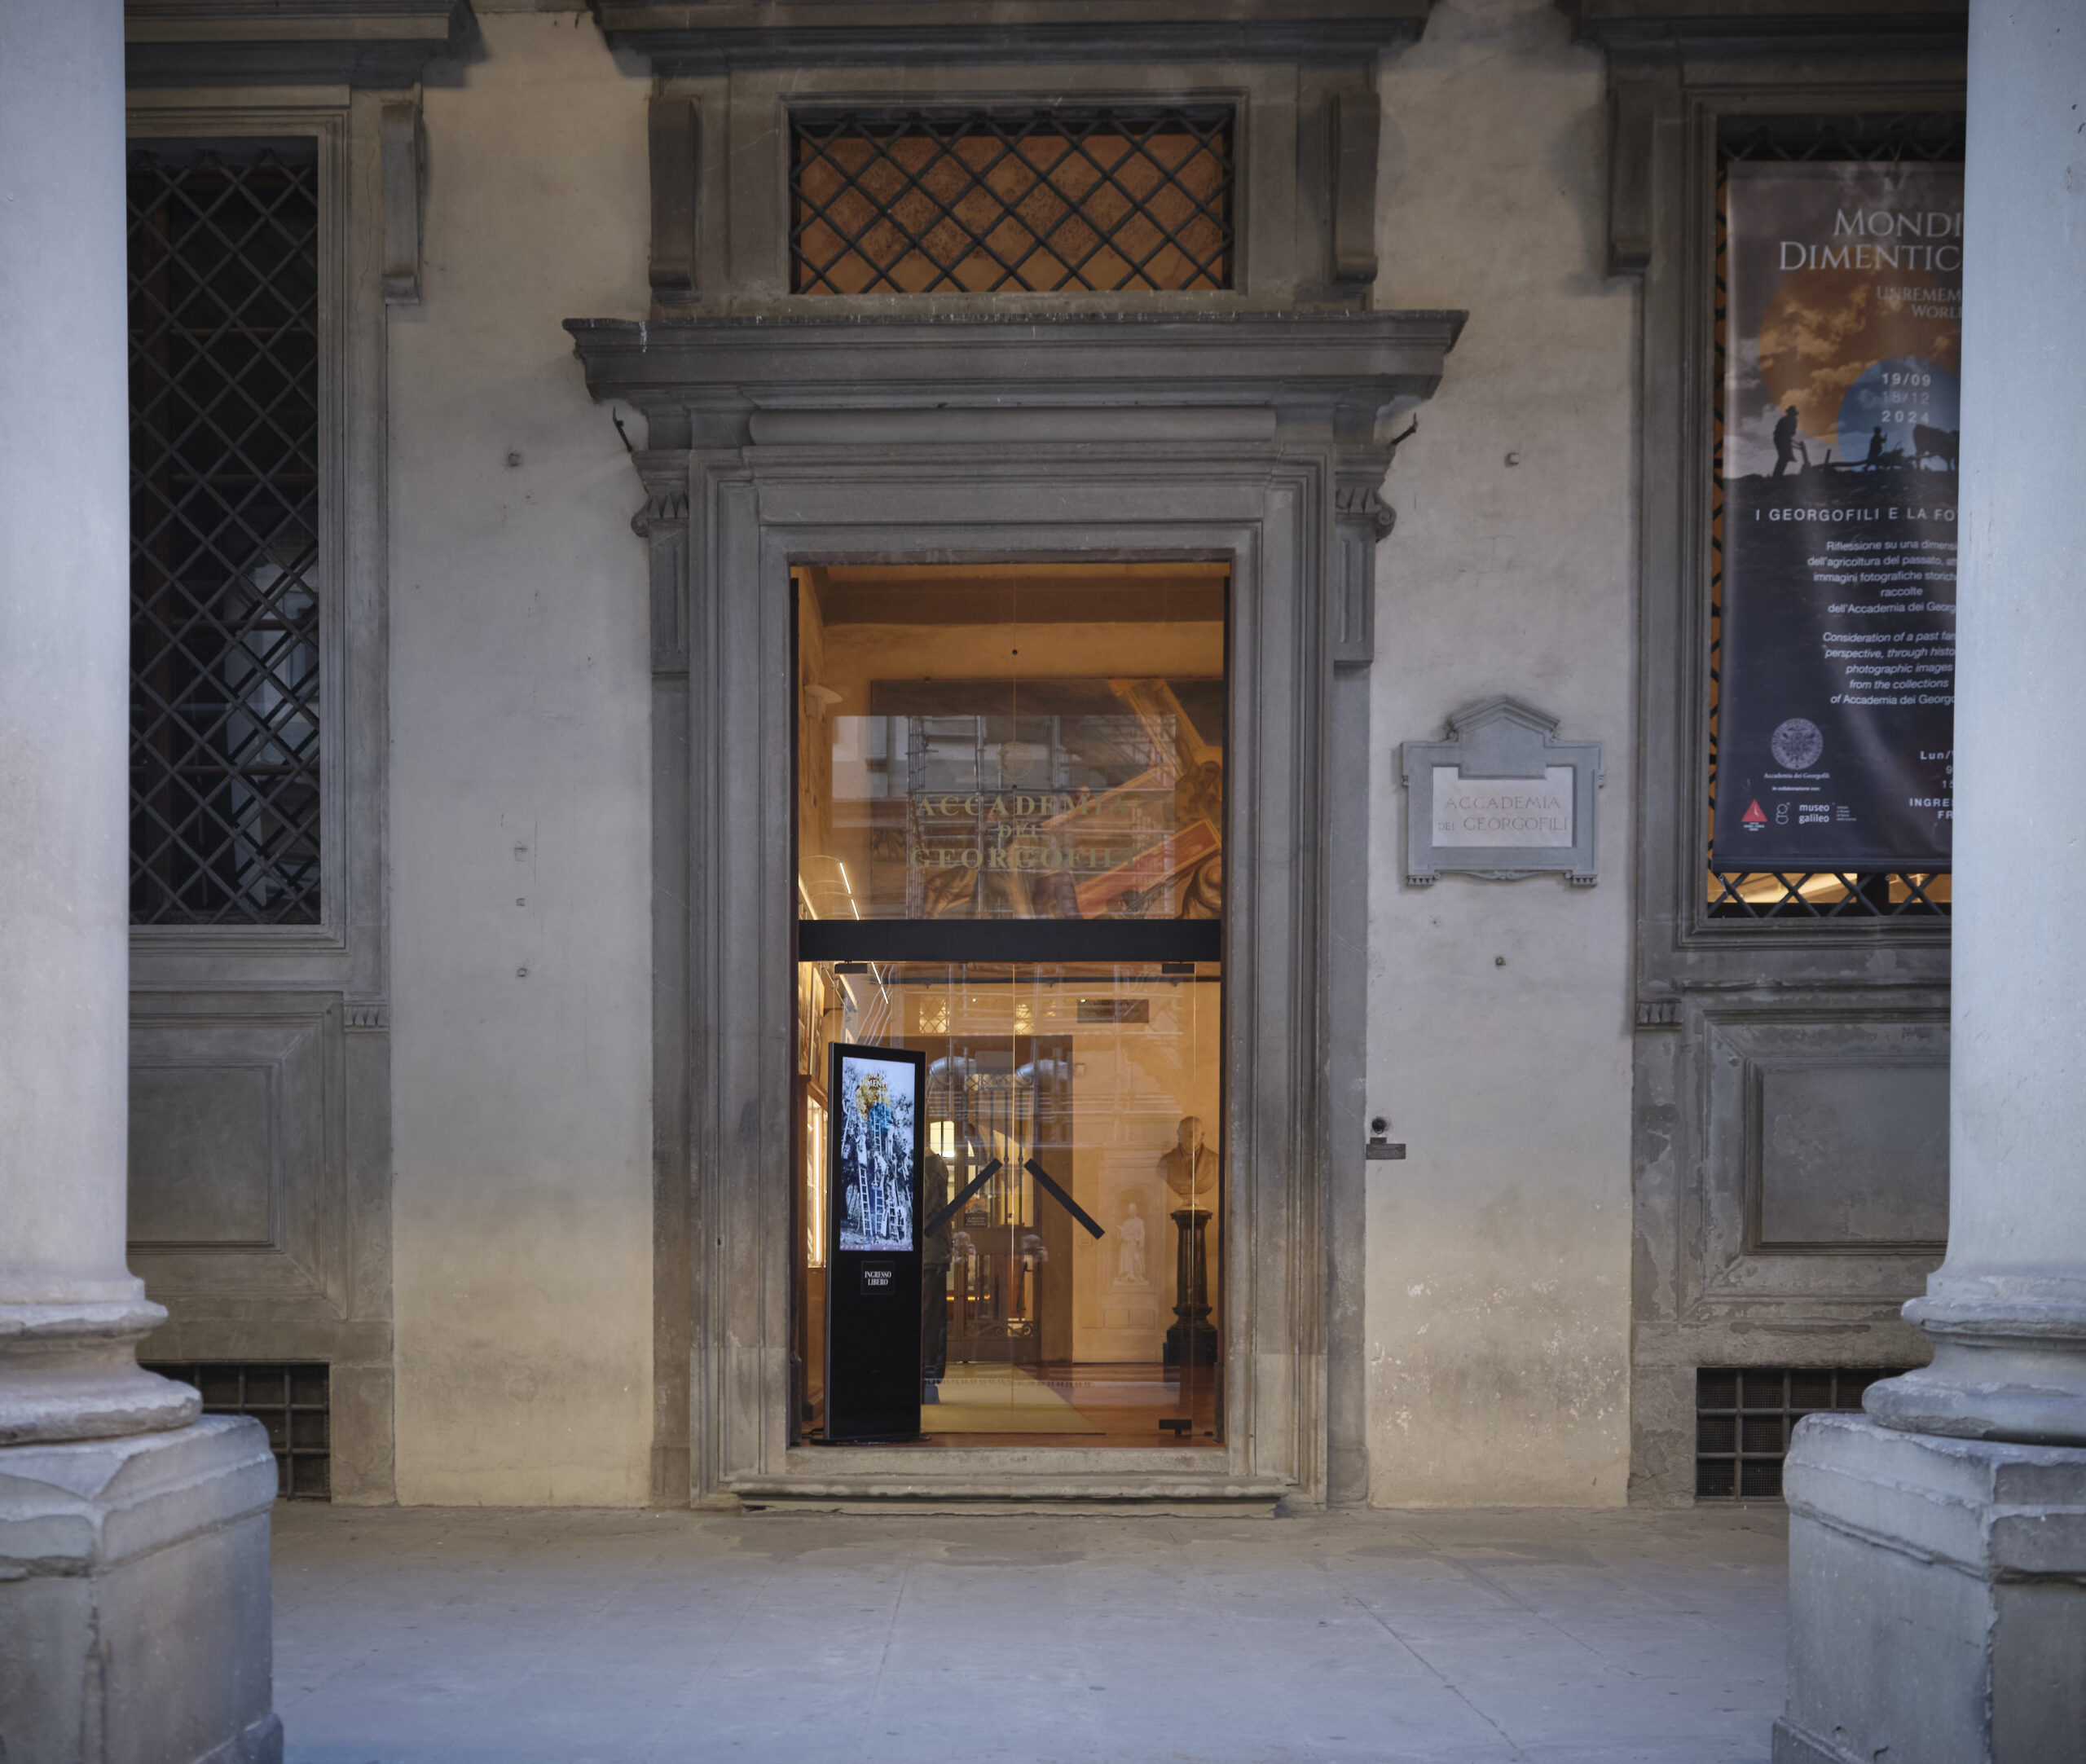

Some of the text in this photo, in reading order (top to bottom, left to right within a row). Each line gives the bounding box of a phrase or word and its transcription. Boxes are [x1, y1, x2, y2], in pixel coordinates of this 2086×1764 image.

[1833, 208, 1962, 238] MONDI
[1779, 241, 1963, 271] DIMENTIC
[1881, 372, 1931, 387] 19/09
[1881, 391, 1930, 405] 18/12
[1881, 410, 1930, 425] 2024
[1768, 508, 1880, 522] GEORGOFILI
[1888, 507, 1899, 520] E
[1907, 507, 1927, 520] LA
[1934, 508, 1957, 522] FO
[1826, 541, 1882, 552] Riflessione
[1884, 540, 1897, 549] su
[1899, 540, 1918, 549] una
[1807, 556, 1881, 569] dell'agricoltura
[1883, 556, 1899, 565] del
[1902, 556, 1944, 567] passato,
[1814, 573, 1858, 584] immagini
[1860, 571, 1922, 584] fotografiche
[1880, 587, 1923, 597] raccolte
[1828, 603, 1906, 614] dell'Accademia
[1908, 602, 1924, 612] dei
[1823, 631, 1890, 643] Consideration
[1893, 631, 1905, 642] of
[1907, 634, 1914, 642] a
[1915, 631, 1939, 644] past
[1824, 649, 1884, 660] perspective,
[1887, 649, 1928, 660] through
[1845, 663, 1953, 676] photographic images
[1849, 679, 1949, 689] from the collections
[1830, 694, 1842, 704] of
[1842, 695, 1898, 705] Accademia
[1899, 695, 1916, 705] dei
[1920, 750, 1953, 760] Lun/
[918, 794, 1129, 816] ACCADEMIA
[1444, 796, 1561, 810] ACCADEMIA
[1798, 803, 1830, 812] museo
[1437, 816, 1568, 832] DEI GEORGOFILI
[1798, 814, 1830, 825] galileo
[999, 824, 1038, 839] DEI
[910, 847, 1136, 869] GEORGOFILI
